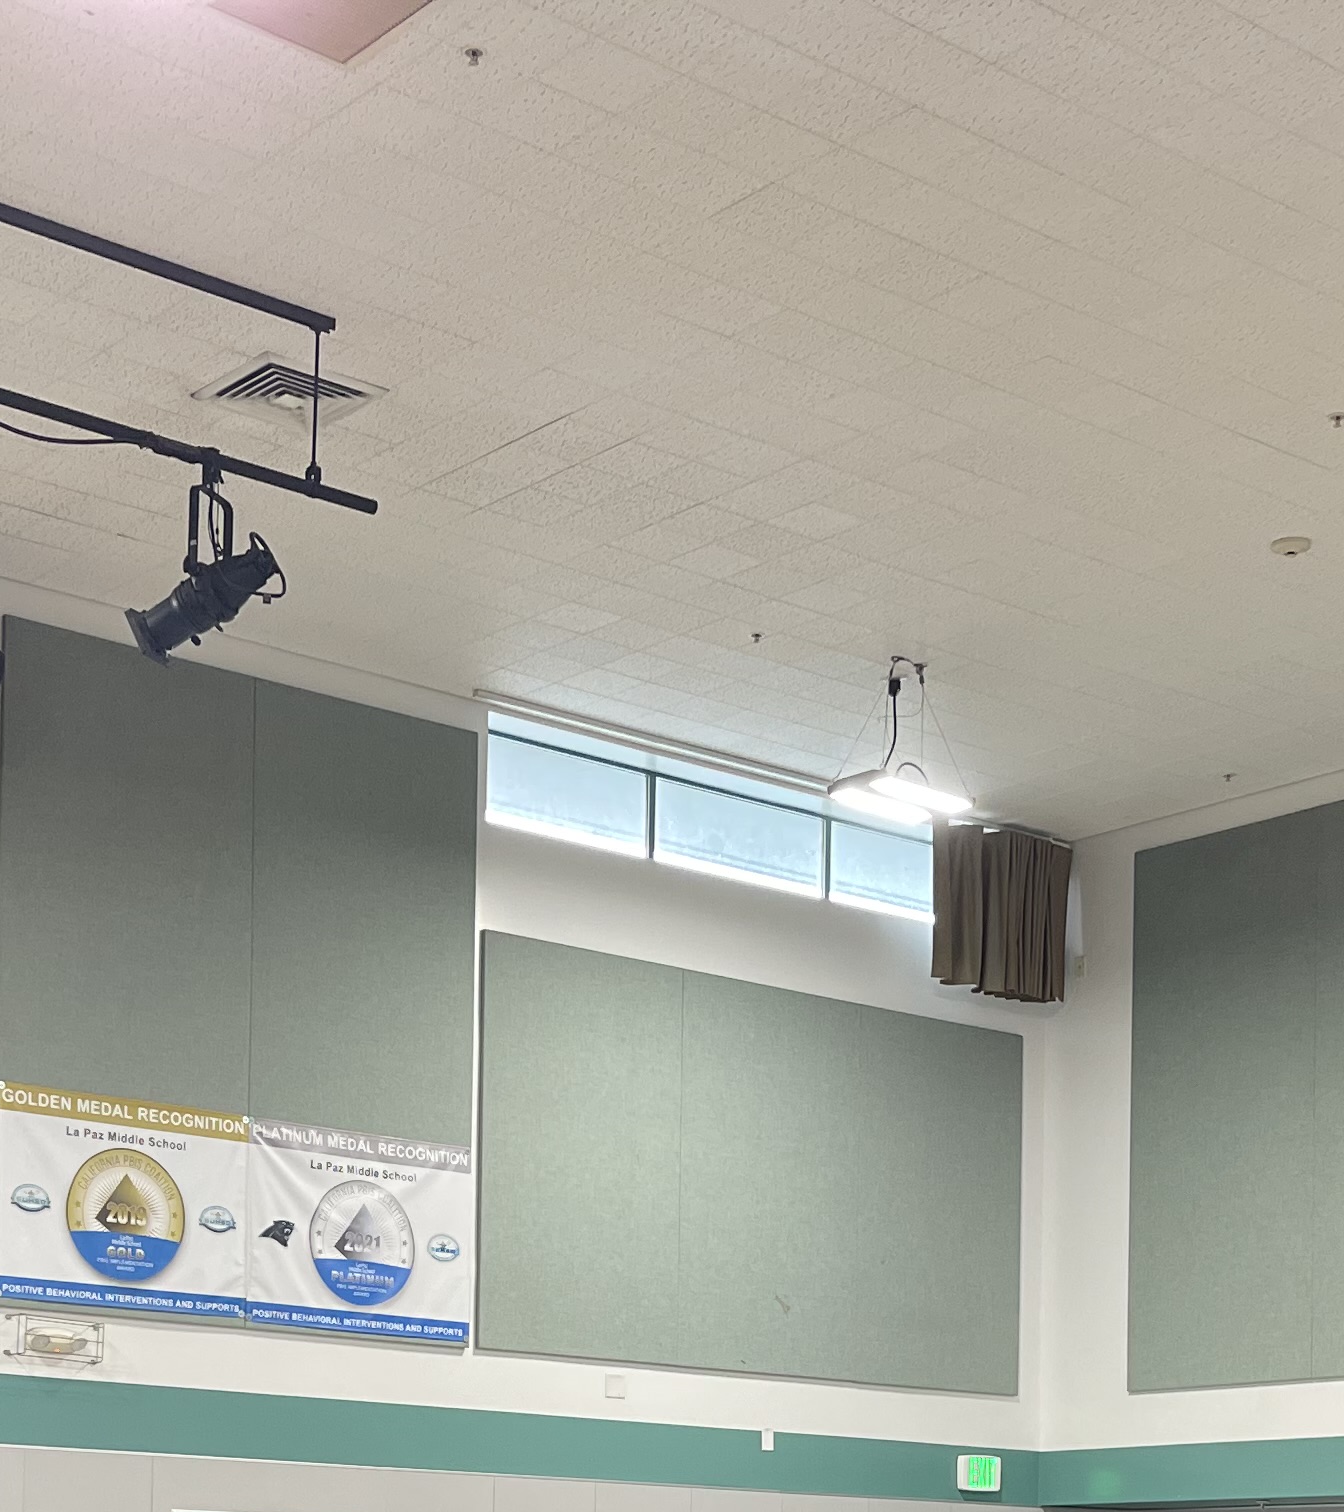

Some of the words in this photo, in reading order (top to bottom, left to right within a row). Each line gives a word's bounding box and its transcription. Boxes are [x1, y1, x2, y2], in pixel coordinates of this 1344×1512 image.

[1, 1088, 72, 1111] GOLDEN
[77, 1098, 133, 1120] MEDAL
[137, 1106, 245, 1135] RECOGNITION
[66, 1126, 80, 1137] La
[84, 1128, 104, 1140] Paz
[108, 1131, 145, 1146] Middle
[148, 1136, 187, 1151] School
[253, 1123, 324, 1147] PLATINUM
[327, 1134, 374, 1154] MEDAL
[377, 1141, 469, 1167] RECOGNITION
[310, 1159, 323, 1170] La
[326, 1162, 344, 1174] Paz
[346, 1165, 379, 1178] Middle
[382, 1169, 417, 1183] School
[106, 1200, 147, 1227] 2019
[106, 1245, 145, 1260] GOLD
[343, 1230, 381, 1253] 2021
[2, 1283, 44, 1296] POSITIVE
[46, 1286, 104, 1301] BEHAVIORAL
[105, 1293, 174, 1308] INTERVENTIONS
[175, 1299, 194, 1310] AND
[252, 1308, 290, 1320] POSITIVE
[291, 1312, 342, 1326] BEHAVIORAL
[343, 1318, 404, 1331] INTERVENTIONS
[405, 1323, 423, 1333] AND
[968, 1456, 998, 1488] EXIT
